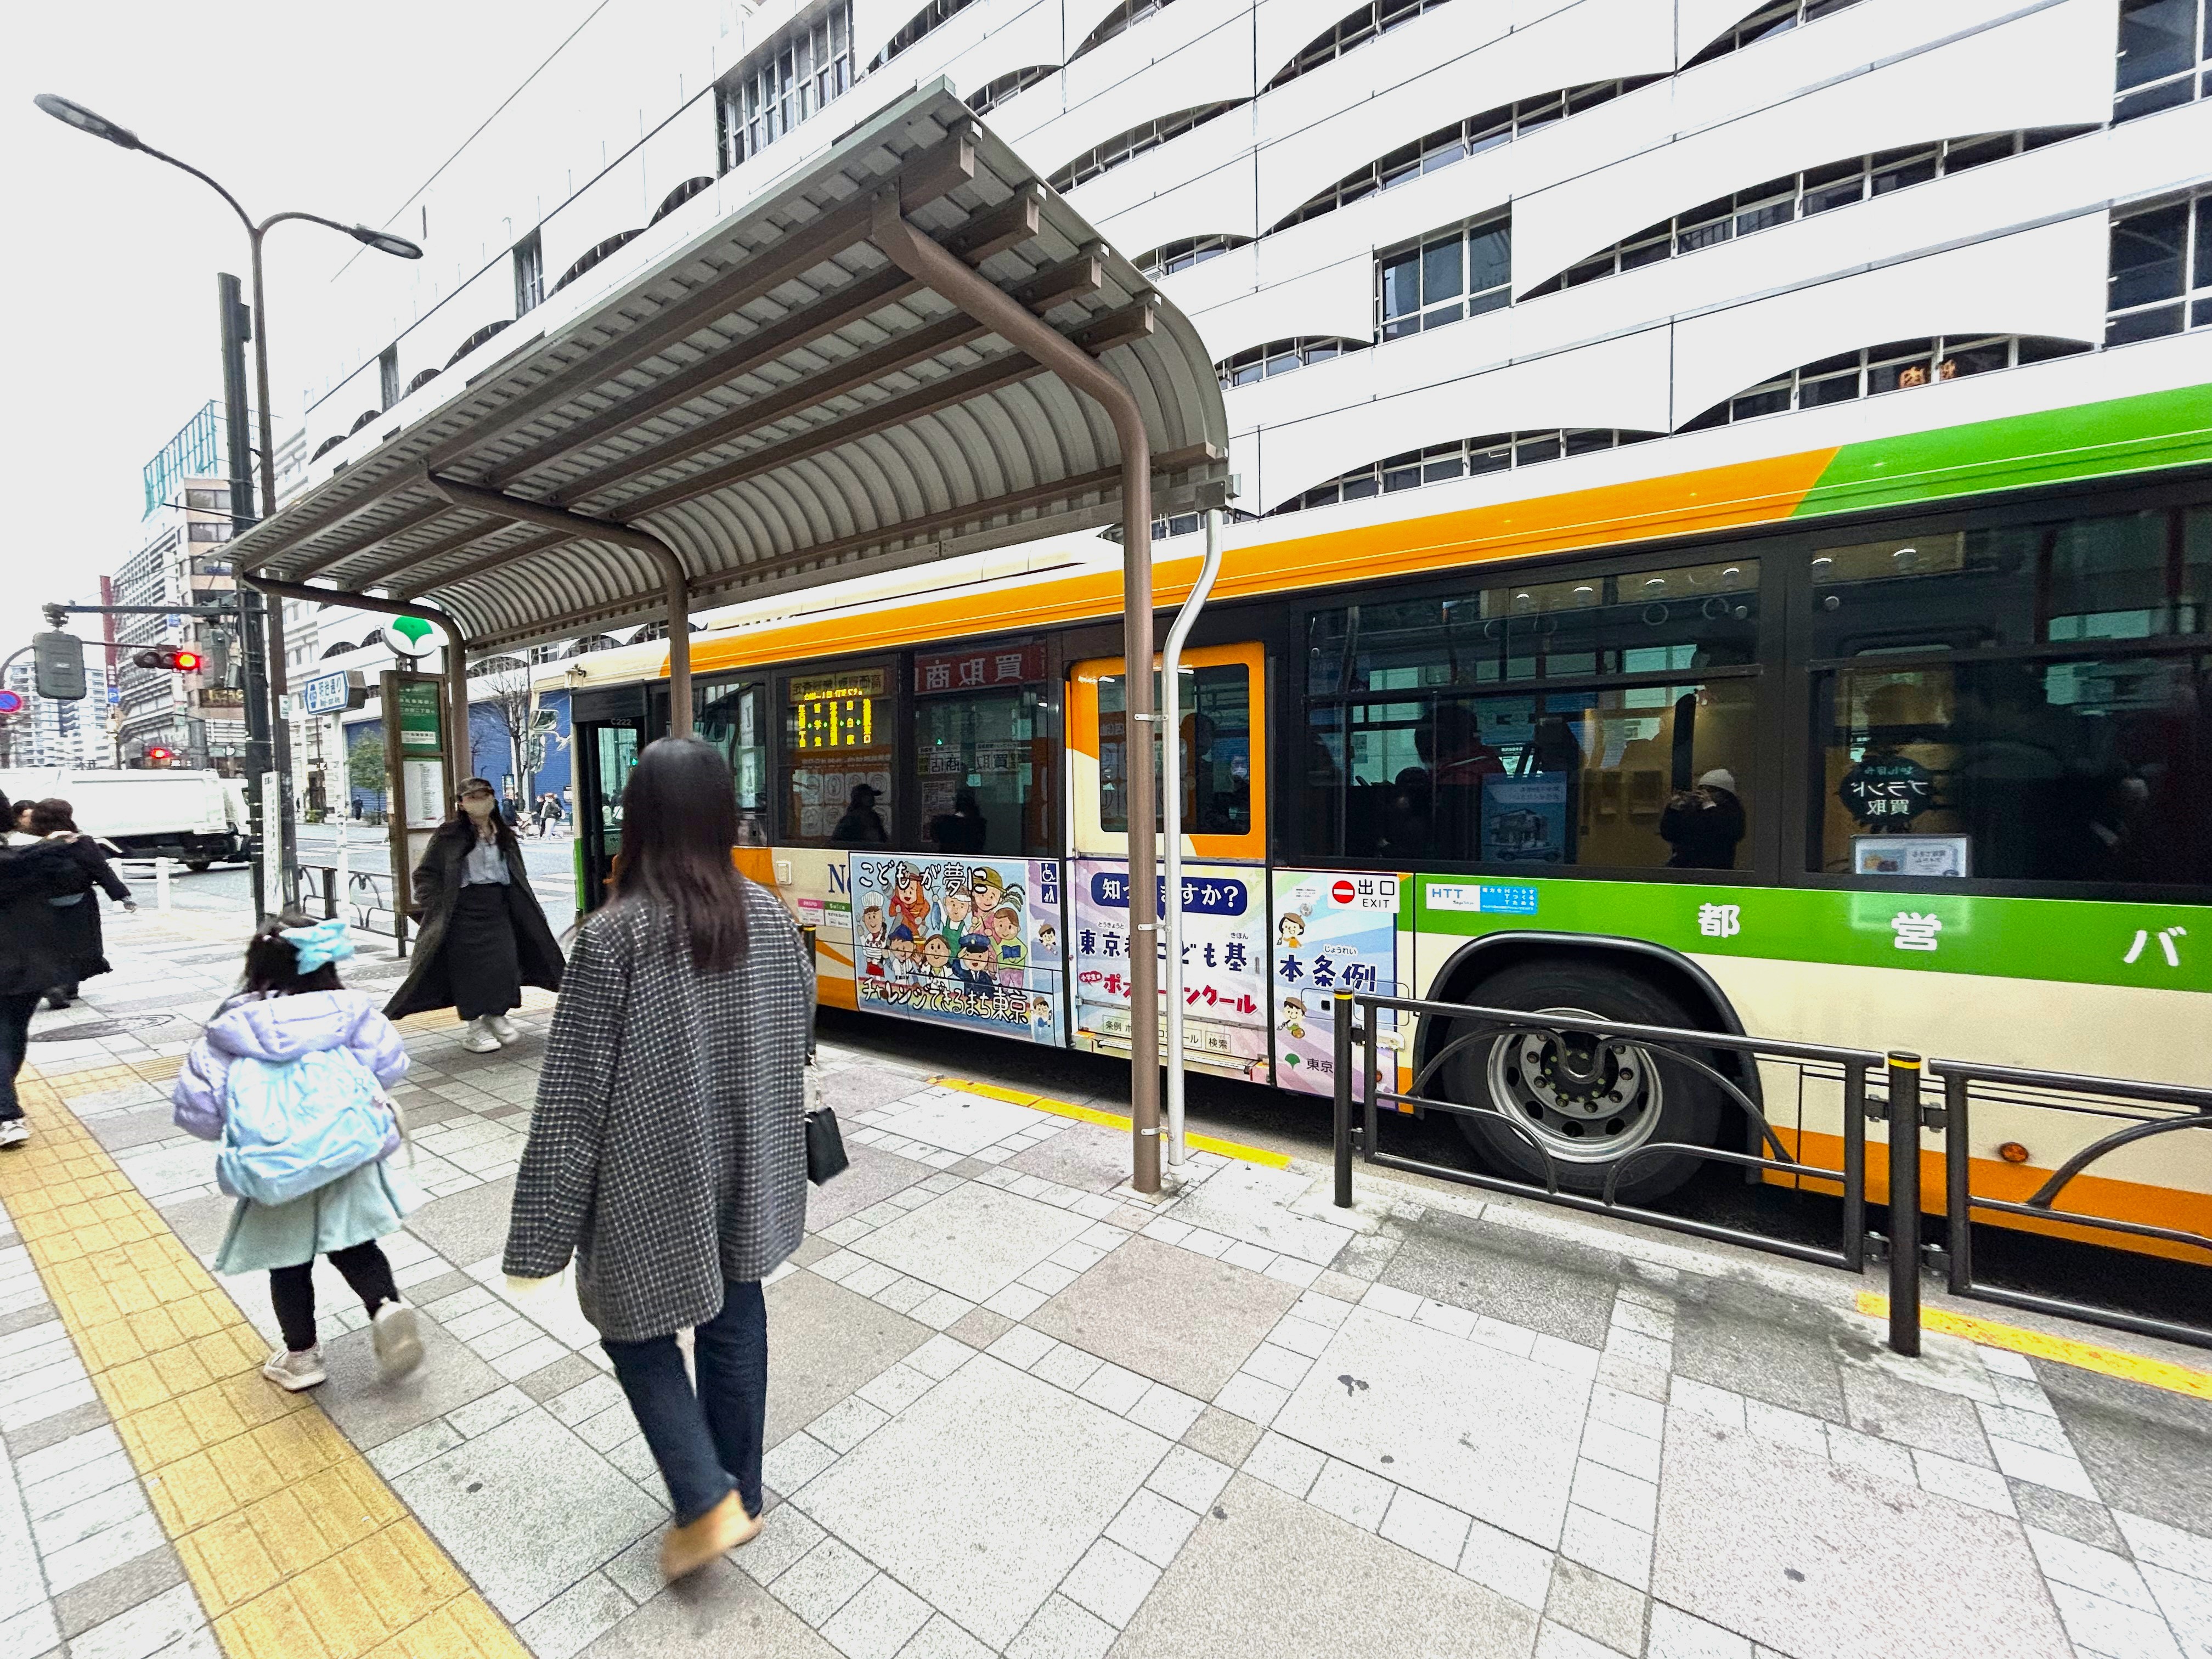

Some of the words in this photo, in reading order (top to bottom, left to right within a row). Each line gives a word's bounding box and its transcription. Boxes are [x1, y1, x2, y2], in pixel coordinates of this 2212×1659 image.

[859, 861, 988, 896] こどもが夢に
[1358, 879, 1395, 896] 出口
[1432, 888, 1464, 899] HTT
[1362, 898, 1390, 909] EXIT
[1324, 946, 1357, 955] じょうれい
[1105, 1020, 1121, 1032] 条例
[1209, 1037, 1228, 1049] 検索
